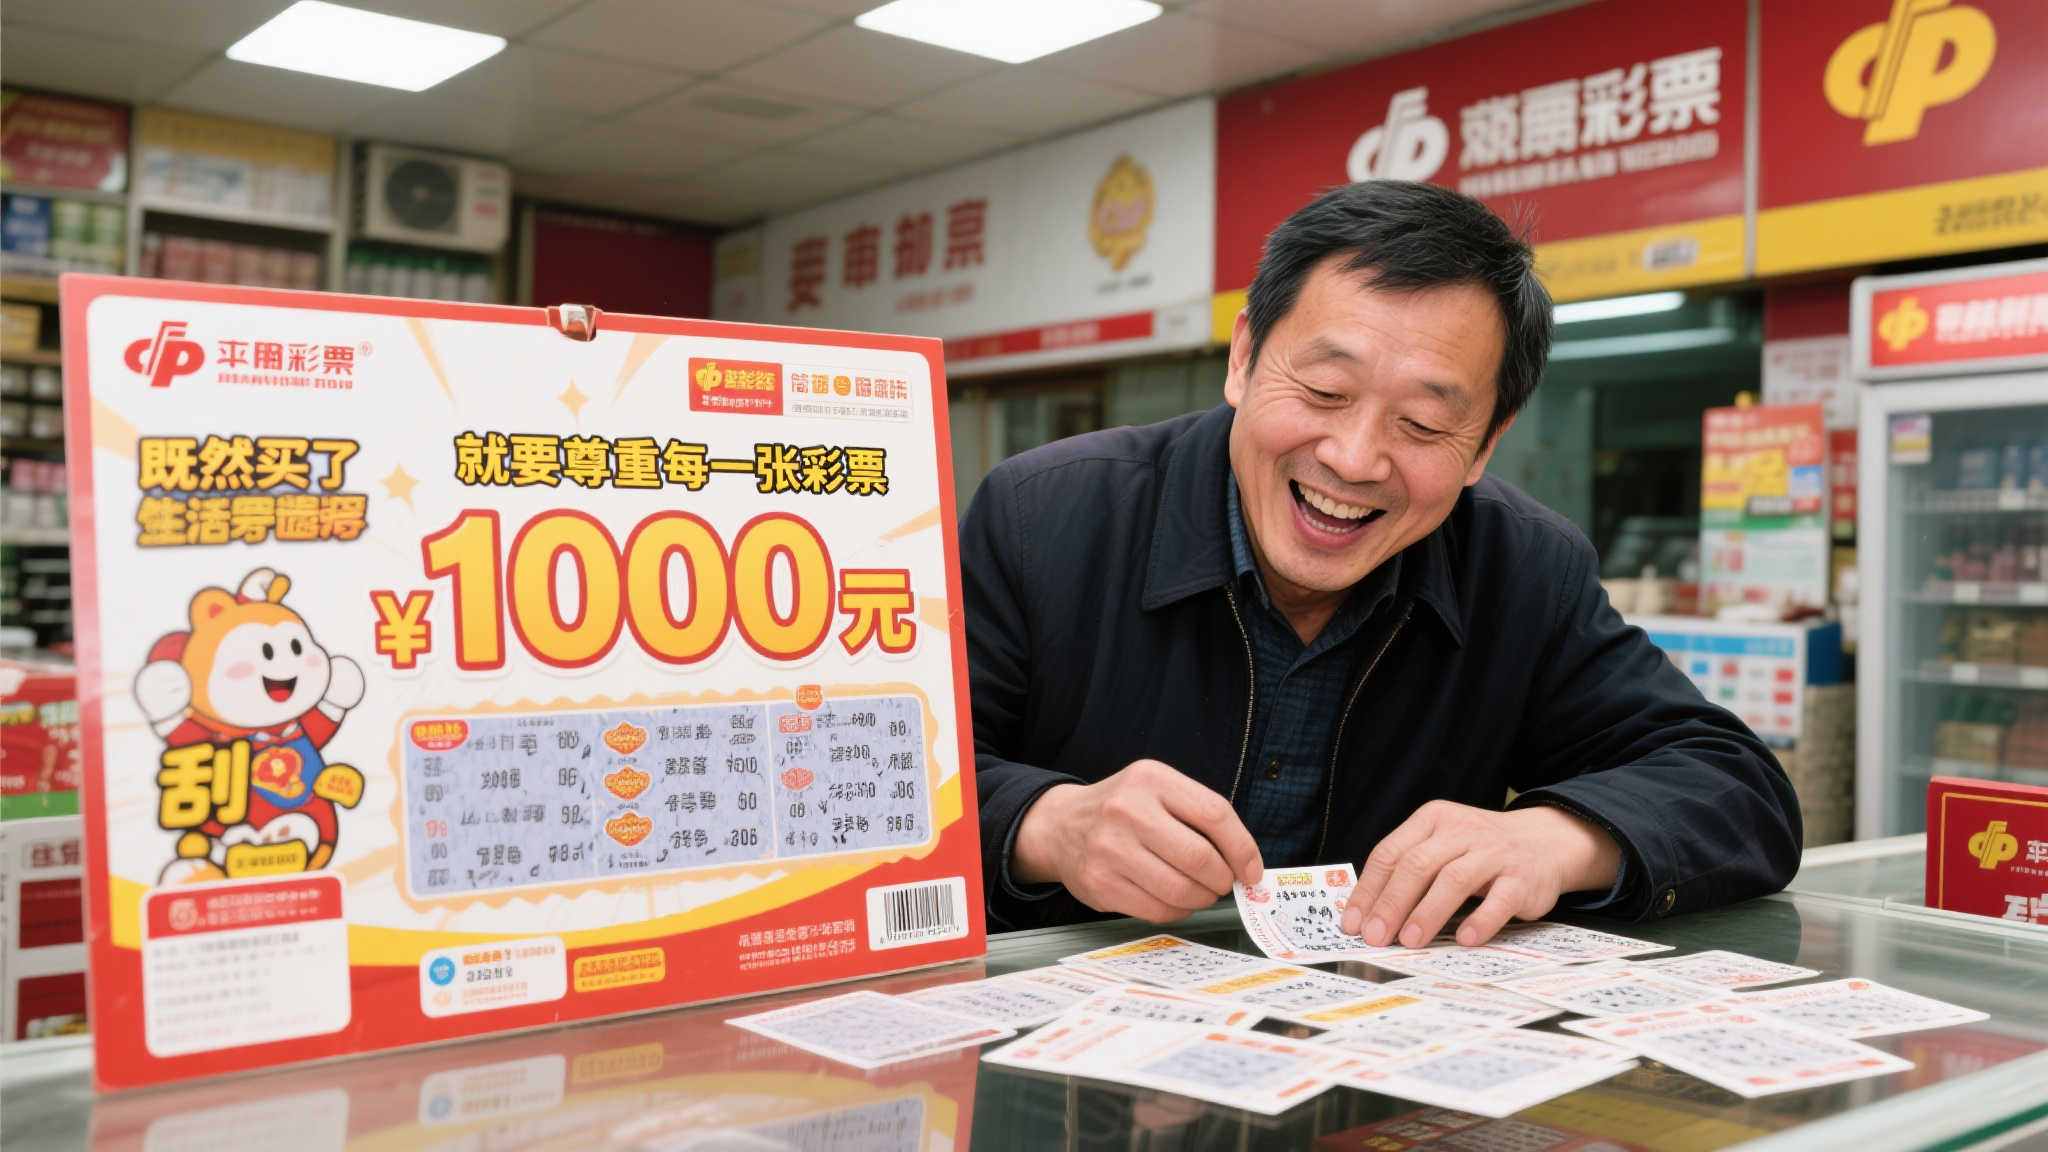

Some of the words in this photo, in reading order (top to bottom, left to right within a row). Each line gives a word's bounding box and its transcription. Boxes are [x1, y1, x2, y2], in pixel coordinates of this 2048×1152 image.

[138, 434, 360, 491] 既然买了
[455, 432, 889, 496] 就要尊重每一张彩票
[157, 738, 251, 831] 刮
